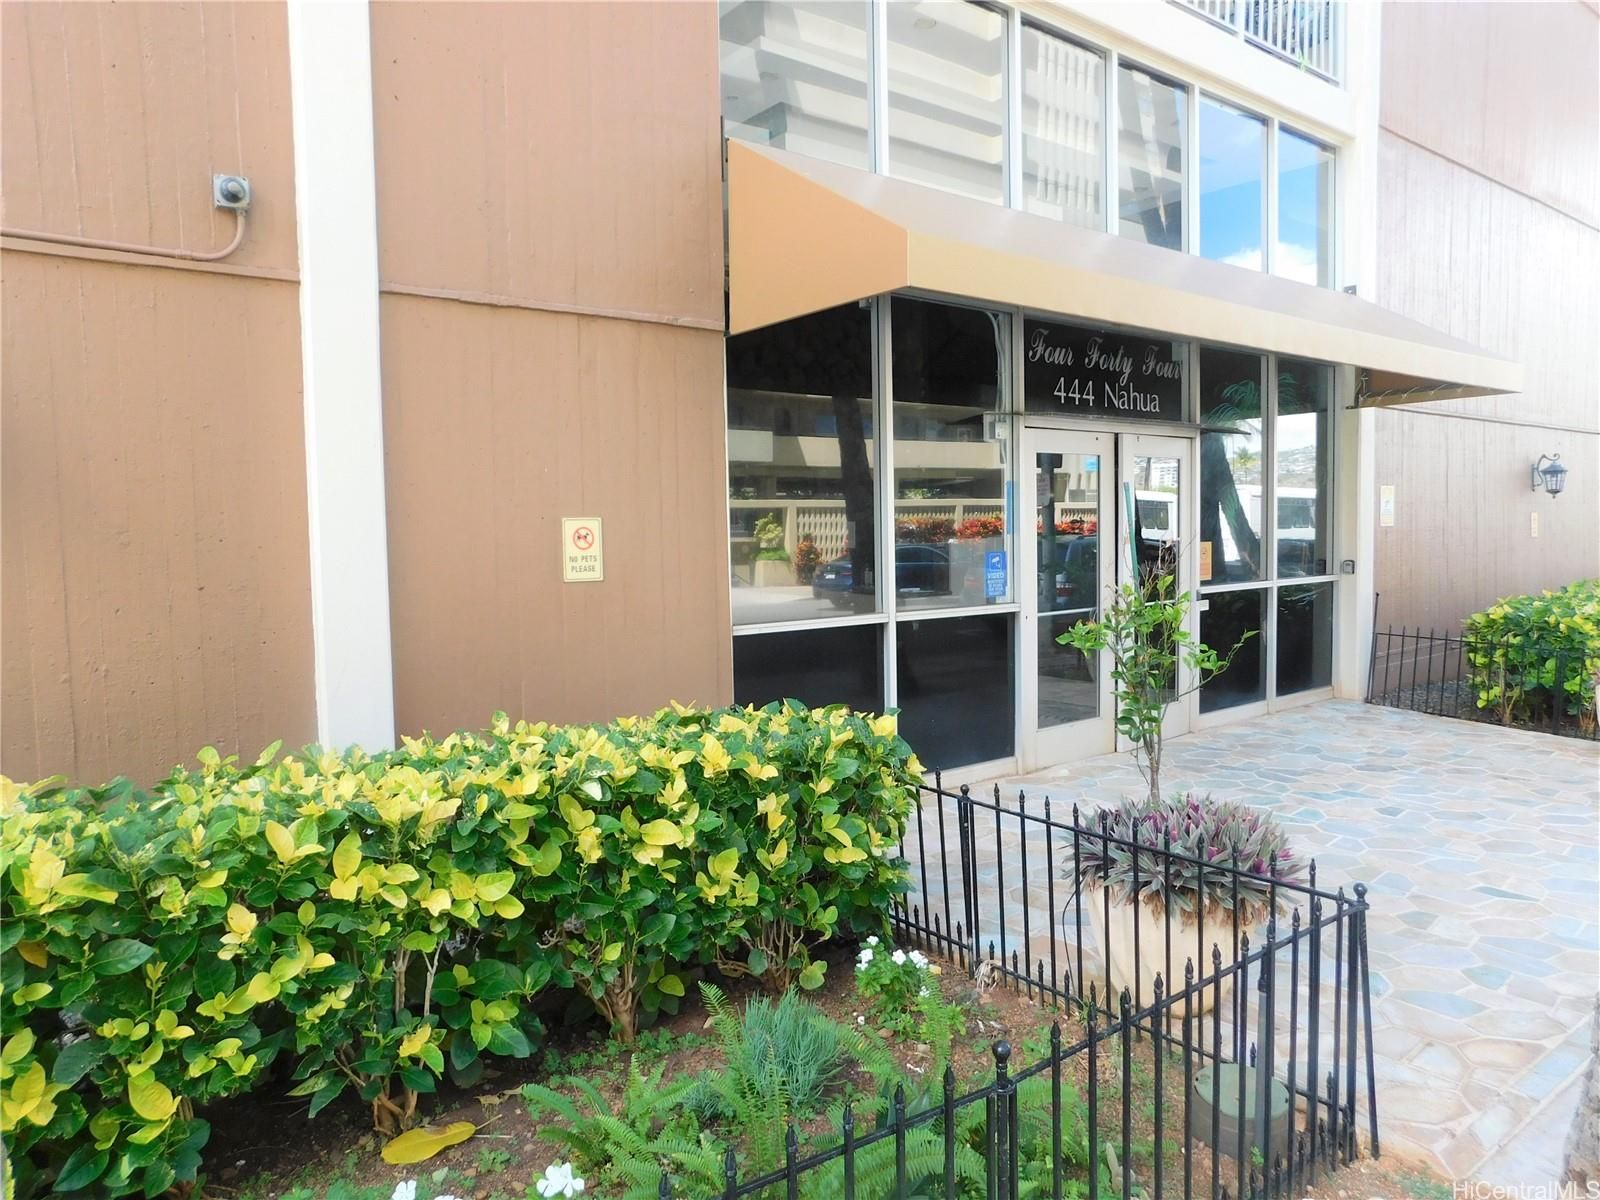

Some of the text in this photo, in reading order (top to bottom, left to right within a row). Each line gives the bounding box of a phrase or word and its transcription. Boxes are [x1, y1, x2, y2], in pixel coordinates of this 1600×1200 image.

[1028, 328, 1183, 386] Four Forty Four
[1053, 376, 1160, 413] 444 Nahua
[571, 565, 596, 573] PLEASE
